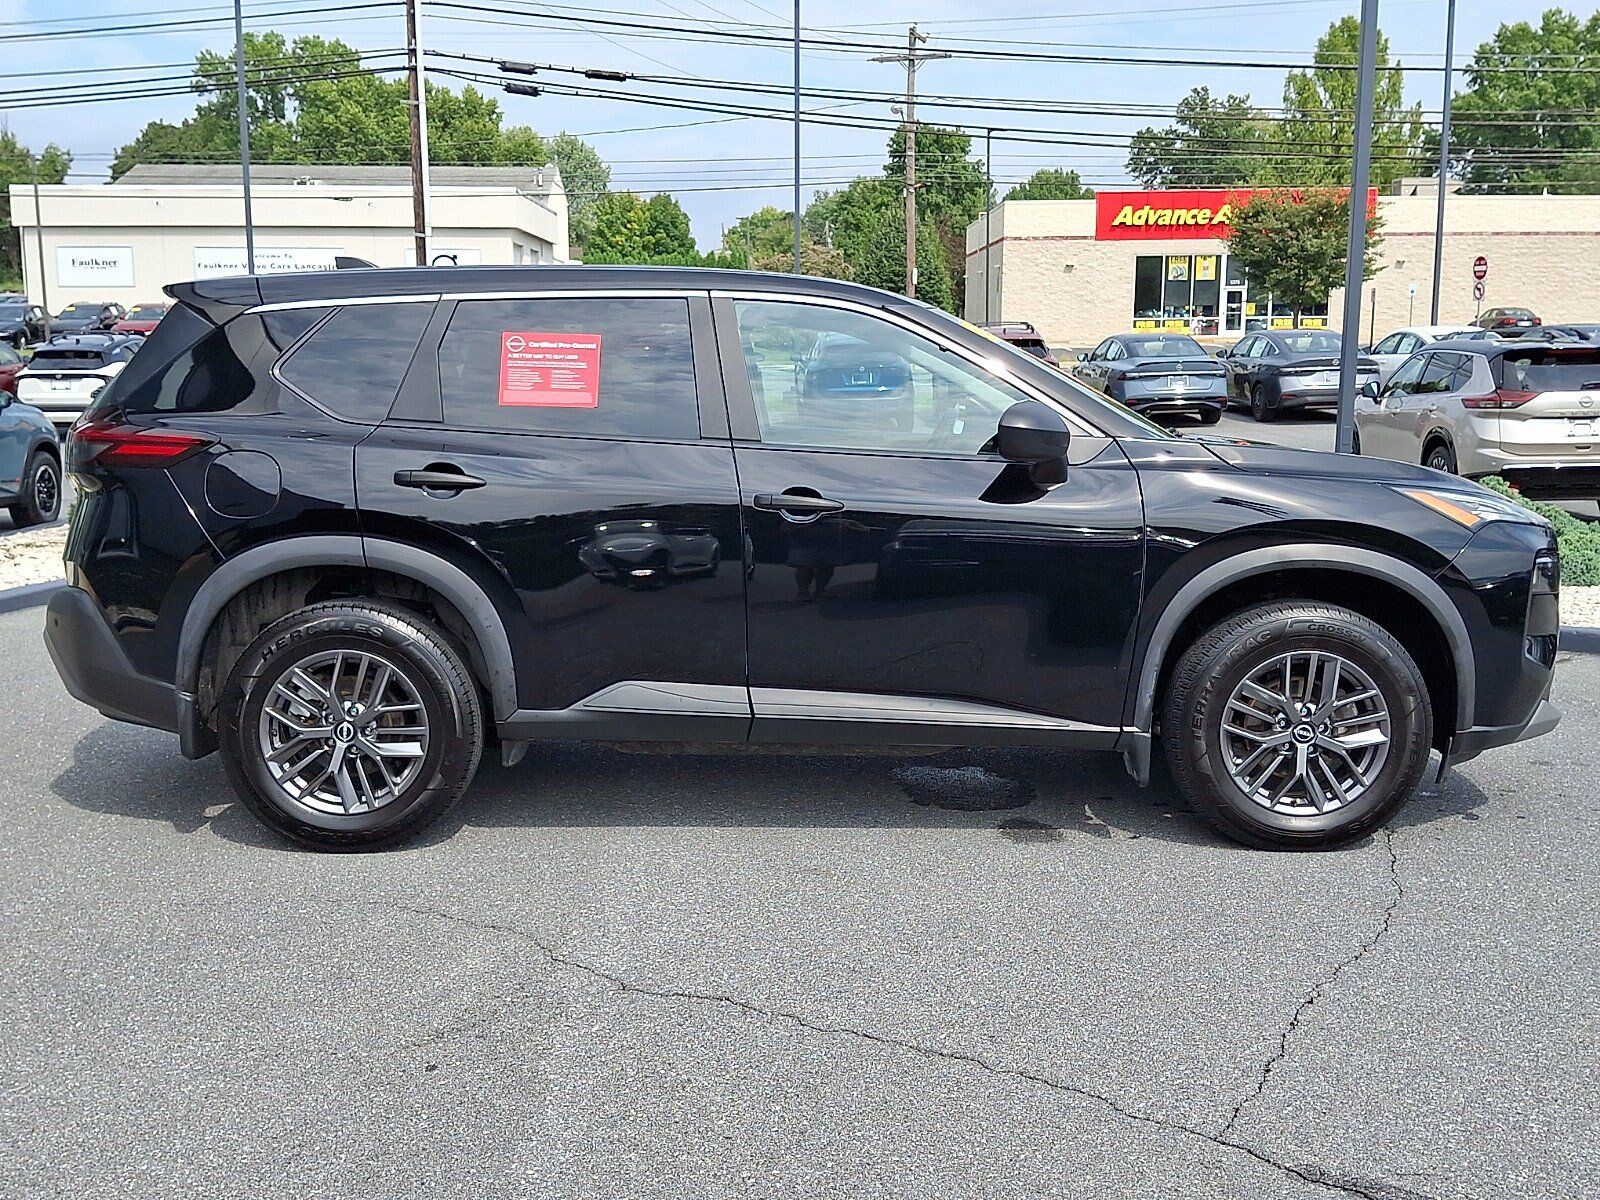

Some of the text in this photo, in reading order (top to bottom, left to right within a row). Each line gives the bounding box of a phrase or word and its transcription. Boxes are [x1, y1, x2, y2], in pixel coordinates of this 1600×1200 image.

[1111, 205, 1211, 226] Advance
[71, 258, 119, 267] Faulkner
[260, 621, 385, 662] HERCULES
[1191, 630, 1273, 742] TERRA TRAC
